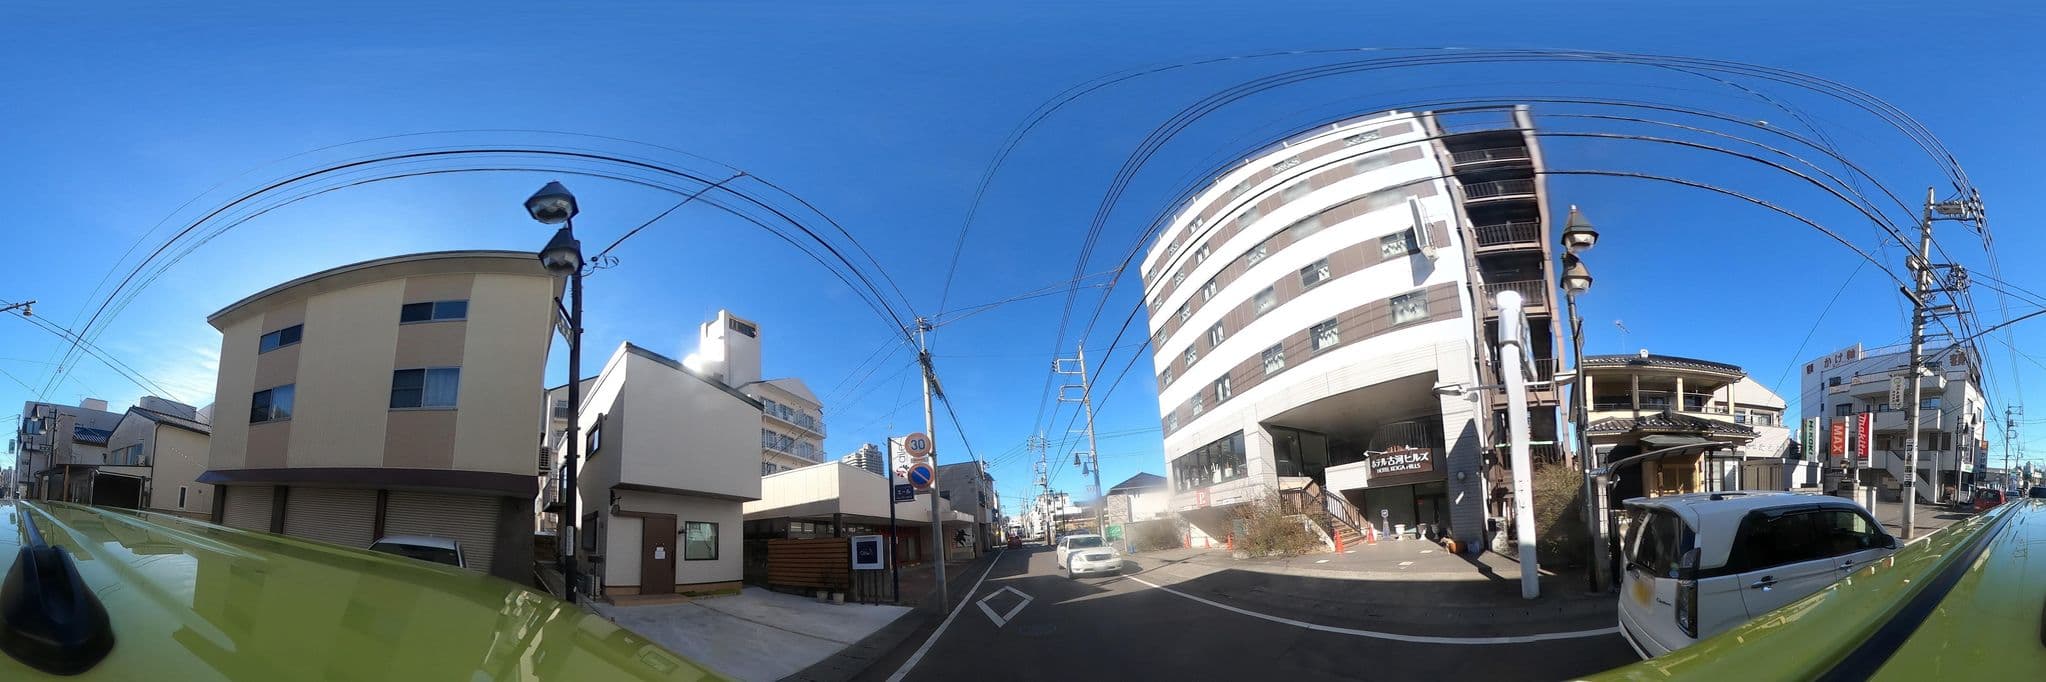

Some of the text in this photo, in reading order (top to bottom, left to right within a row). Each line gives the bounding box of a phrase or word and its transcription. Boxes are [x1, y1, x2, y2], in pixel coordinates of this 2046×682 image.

[911, 439, 925, 450] 30
[1833, 425, 1843, 453] MAX
[1372, 452, 1429, 468] ホテル古河ヒルズ
